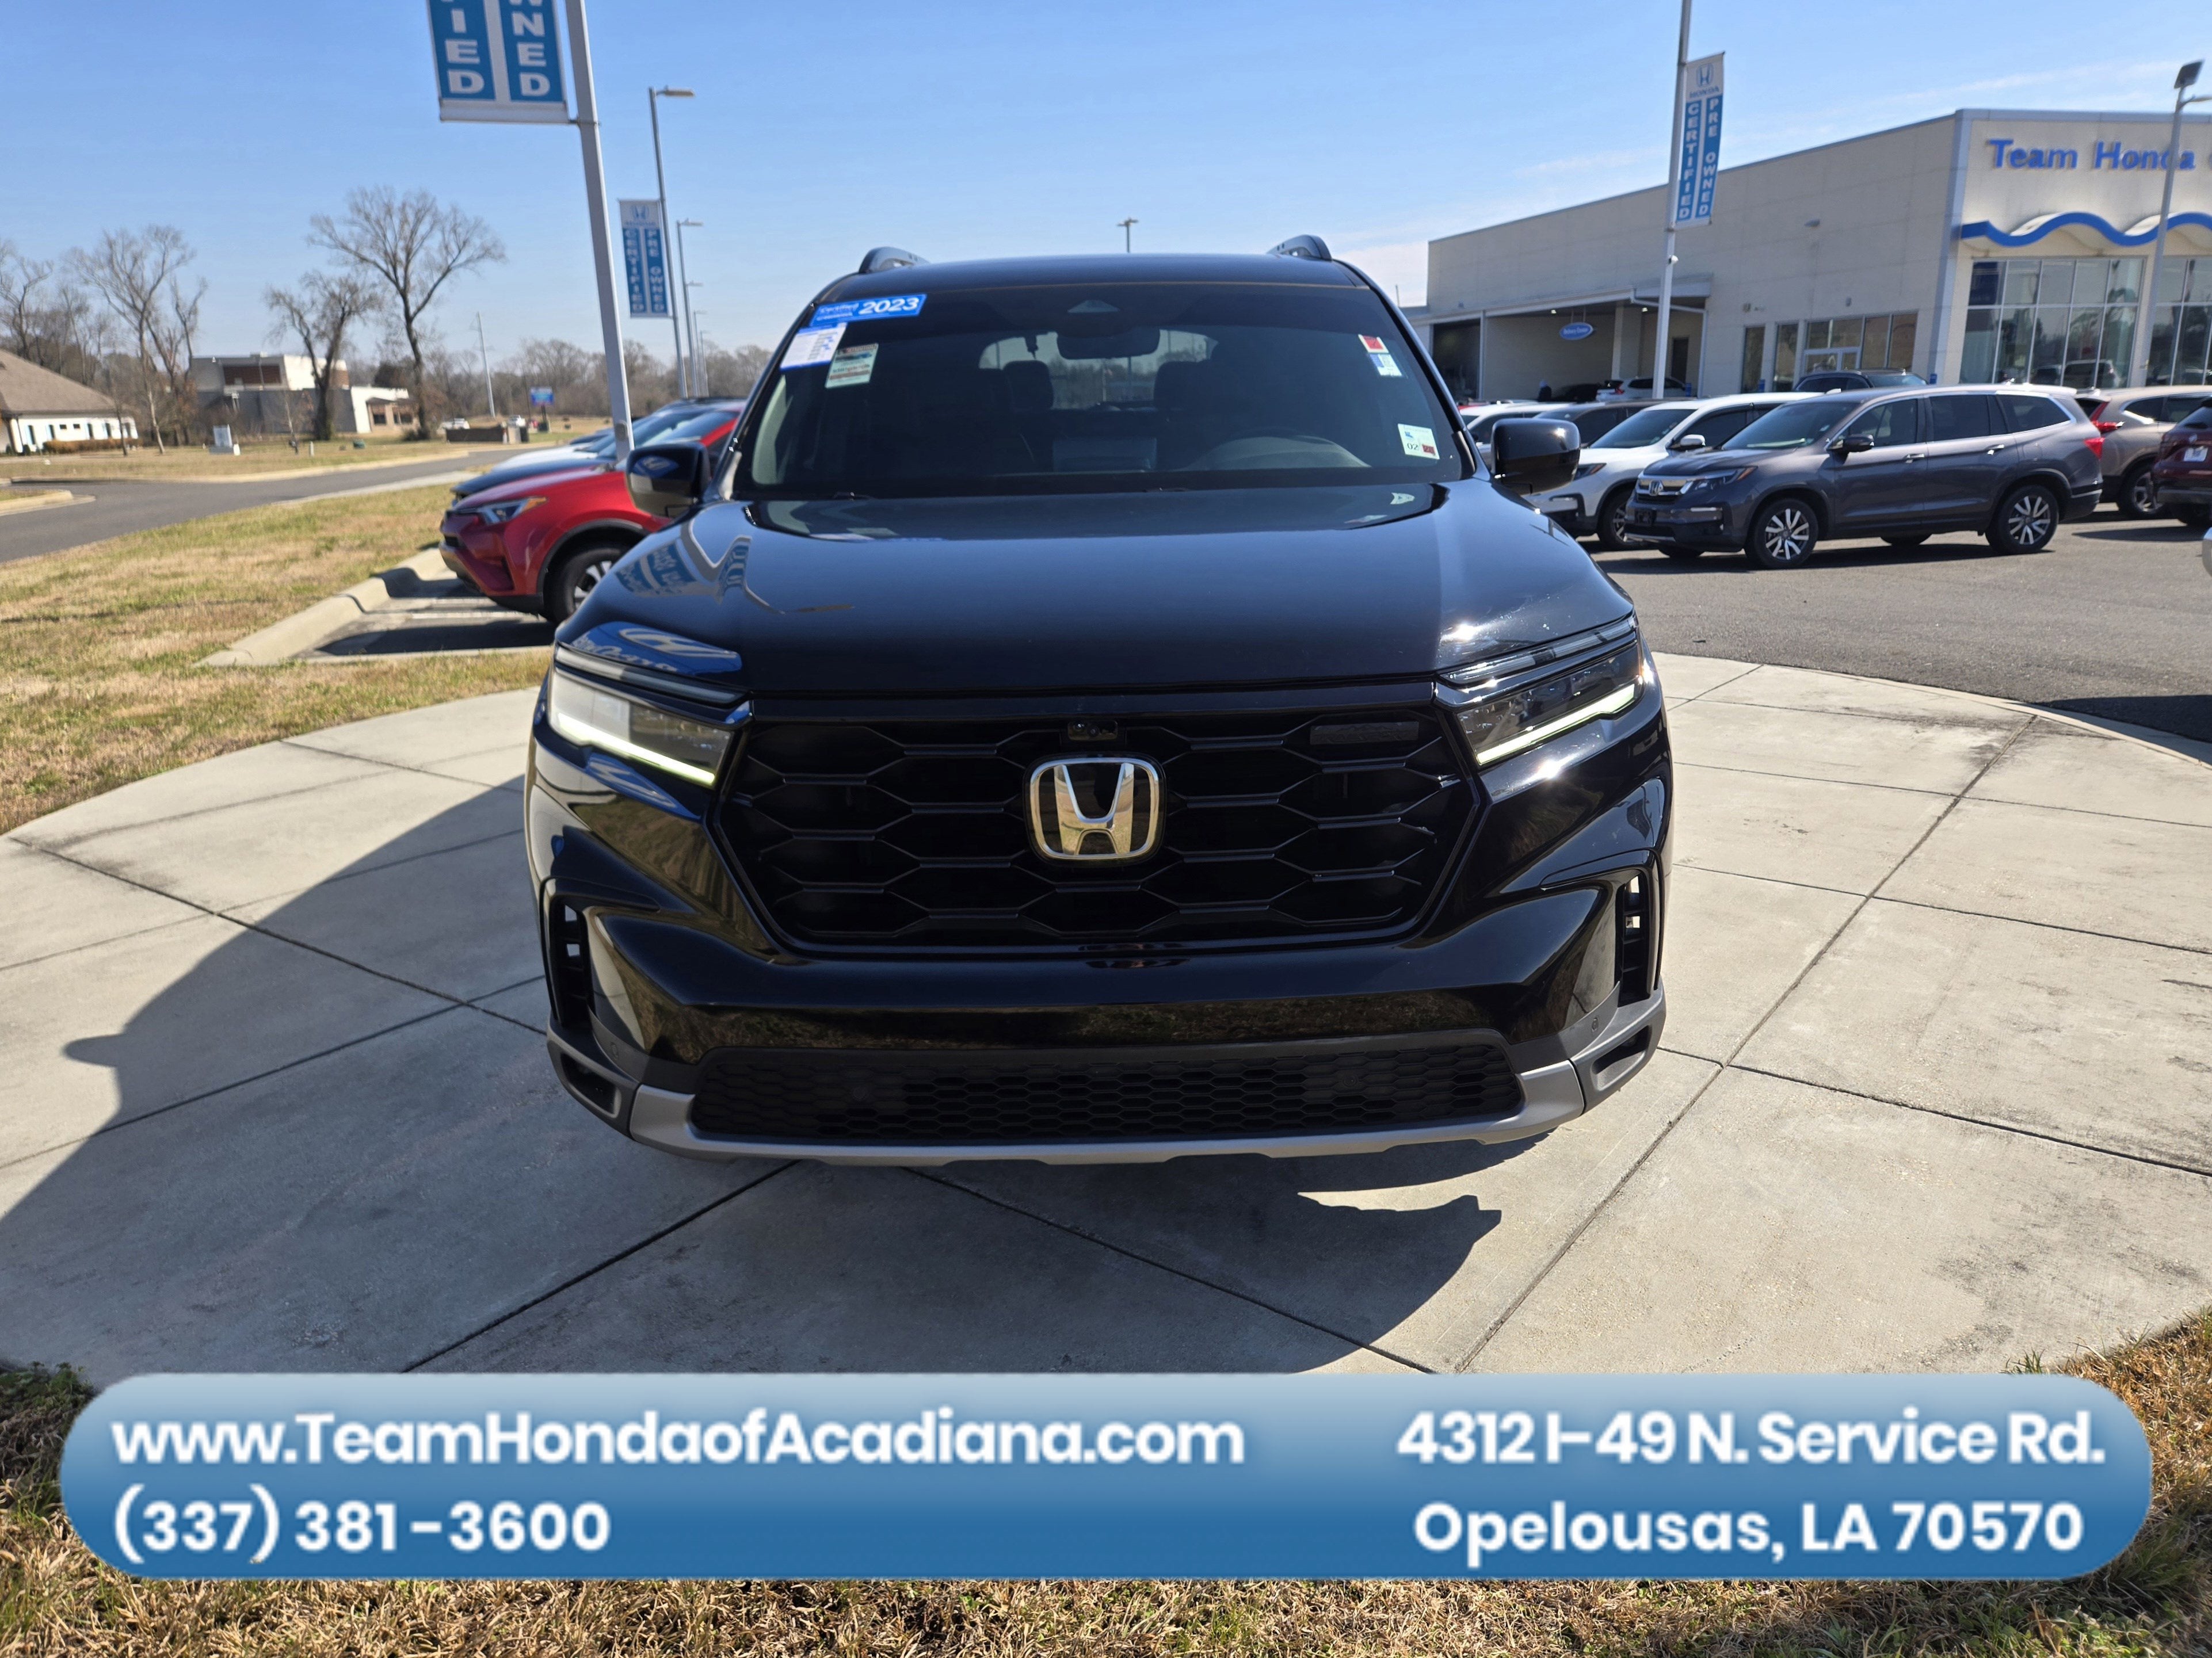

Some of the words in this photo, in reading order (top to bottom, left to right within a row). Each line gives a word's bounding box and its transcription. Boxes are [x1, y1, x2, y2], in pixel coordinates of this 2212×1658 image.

[441, 0, 485, 94] IED
[509, 0, 551, 97] NED
[1708, 98, 1719, 138] PRE
[1679, 102, 1699, 218] CERTIFIED
[1698, 151, 1716, 216] OWNED
[1988, 138, 2078, 169] Team
[859, 297, 920, 315] 2023
